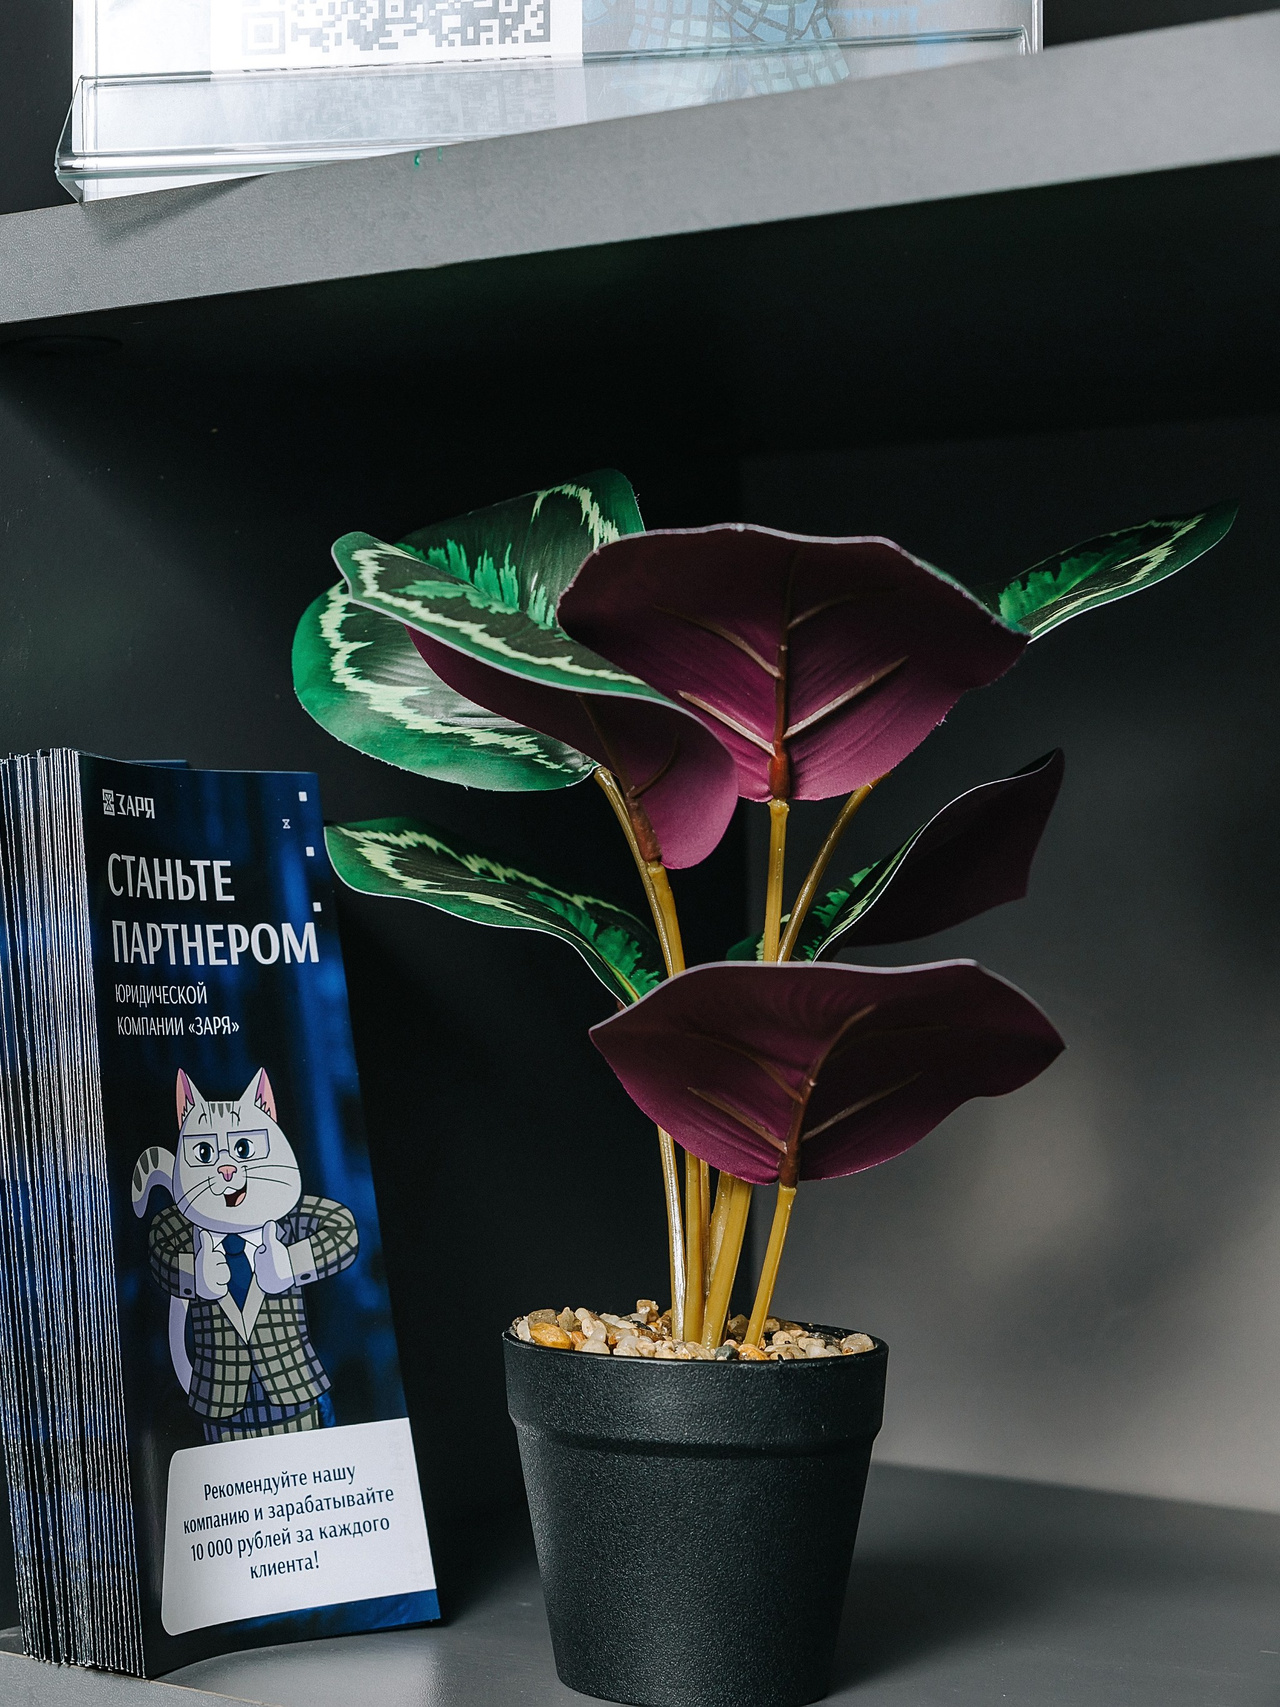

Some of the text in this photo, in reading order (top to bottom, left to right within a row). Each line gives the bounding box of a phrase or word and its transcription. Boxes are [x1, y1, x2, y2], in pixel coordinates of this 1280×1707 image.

[116, 793, 155, 819] ЗАРЯ
[107, 853, 235, 901] СТАНЬТЕ
[111, 920, 320, 966] ПАРТНЕРОМ
[114, 982, 208, 1008] ЮРИДИЧЕСКОЙ
[117, 1016, 240, 1036] КОМПАНИИ «ЗАРЯ»
[203, 1465, 356, 1501] Рекомендуйте нашу
[183, 1488, 395, 1535] компанию и зарабатывайте
[190, 1516, 390, 1562] 10 000 рублей за каждого
[250, 1550, 320, 1579] клиента!
